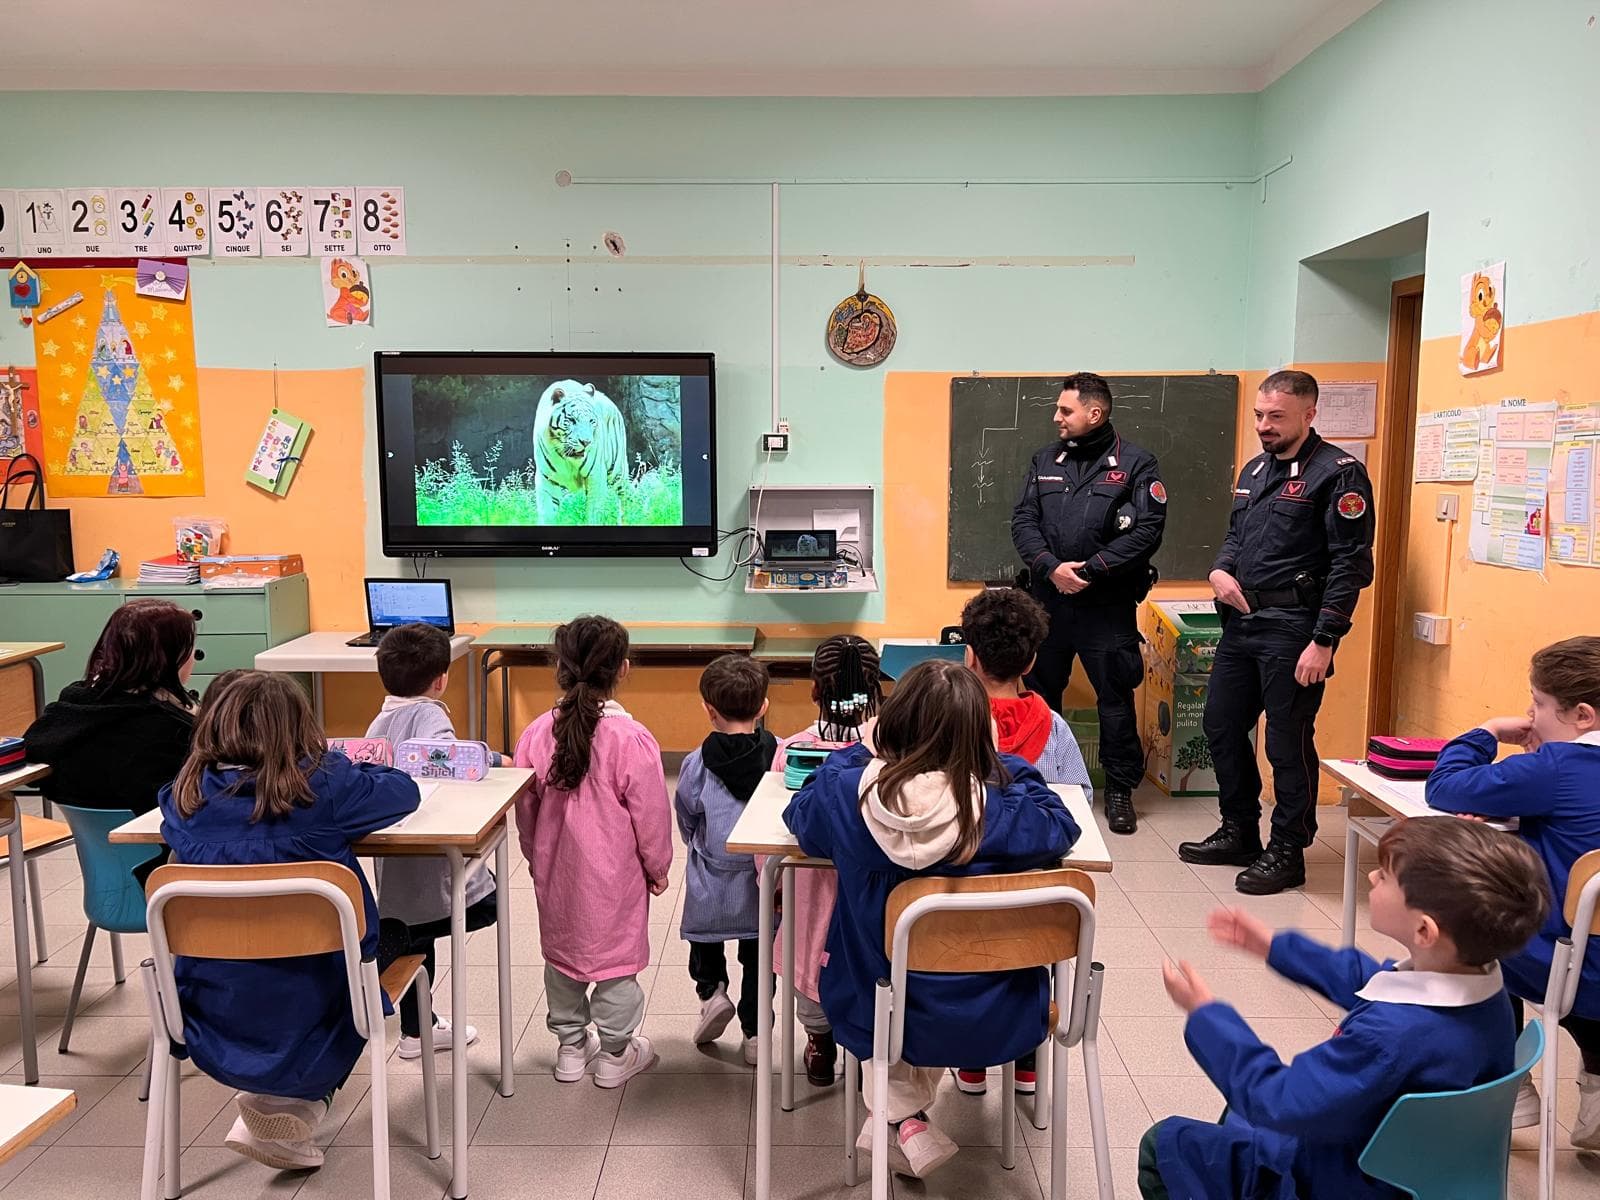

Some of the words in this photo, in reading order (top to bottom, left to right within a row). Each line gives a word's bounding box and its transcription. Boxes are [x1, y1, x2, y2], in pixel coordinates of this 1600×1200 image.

[25, 202, 37, 233] 1
[71, 199, 89, 233] 2
[120, 199, 138, 233] 3
[168, 199, 186, 232] 4
[218, 200, 235, 233] 5
[265, 199, 283, 233] 6
[313, 200, 331, 232] 7
[363, 198, 380, 232] 8
[173, 244, 203, 253] QUATTRO
[1500, 400, 1507, 408] IL
[1508, 399, 1527, 407] NOME
[773, 573, 788, 584] 108
[1176, 719, 1198, 728] pulito
